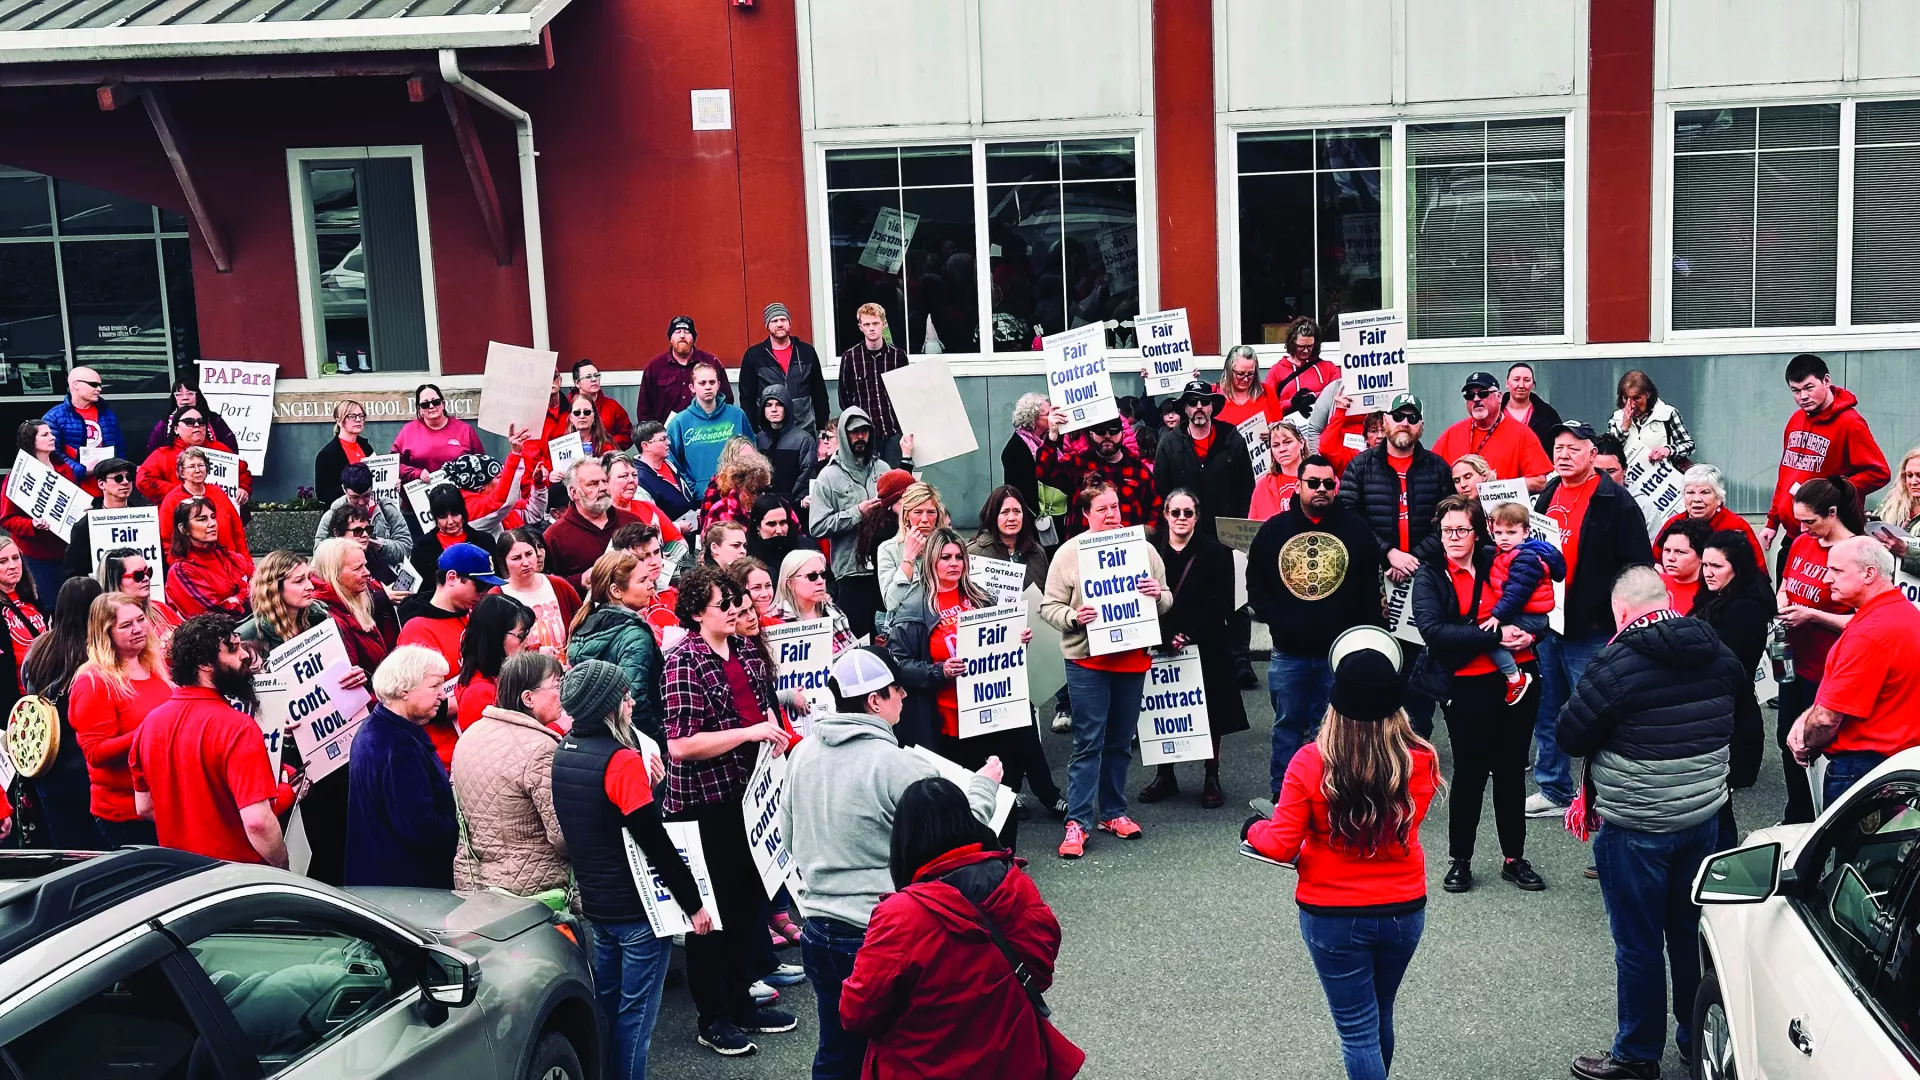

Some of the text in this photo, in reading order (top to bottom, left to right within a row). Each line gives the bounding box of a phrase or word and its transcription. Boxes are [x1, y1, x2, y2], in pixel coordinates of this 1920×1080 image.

[1151, 323, 1173, 339] Fair
[1359, 328, 1387, 346] Fair
[1063, 342, 1088, 362] Fair
[1141, 338, 1190, 358] Contract
[1343, 347, 1405, 370] Contract
[203, 367, 272, 386] PAPara
[1051, 357, 1106, 387] Contract
[1154, 358, 1183, 375] Now!
[1357, 371, 1393, 390] Now!
[1064, 381, 1099, 405] Now!
[219, 402, 252, 418] Port
[272, 397, 473, 418] ANGELE HOOL DRICT
[684, 423, 735, 446] Silverwood
[1244, 431, 1254, 445] ir
[1250, 440, 1271, 460] ract
[1253, 459, 1267, 476] w!
[1626, 462, 1646, 482] air
[19, 472, 37, 497] Fair
[1640, 461, 1673, 497] tract
[30, 470, 59, 520] Contract
[49, 490, 71, 522] Now!
[1490, 490, 1518, 501] CONTRACT
[111, 526, 139, 543] Fair
[1097, 547, 1127, 569] Fair
[984, 566, 1024, 579] CONTRACT
[1800, 561, 1829, 581] SILENT
[985, 581, 1020, 592] DUCATORS!
[1785, 576, 1822, 603] RRECTING
[1101, 598, 1141, 623] Now!
[978, 623, 1008, 647] Fair
[780, 640, 812, 664] Fair
[293, 652, 324, 685] Fair
[773, 666, 831, 691] ntract
[1150, 664, 1181, 686] Fair
[973, 676, 1012, 704] Now!
[288, 684, 331, 722] Cont
[1153, 713, 1194, 736] Now!
[754, 766, 772, 809] Fair
[764, 827, 782, 858] No
